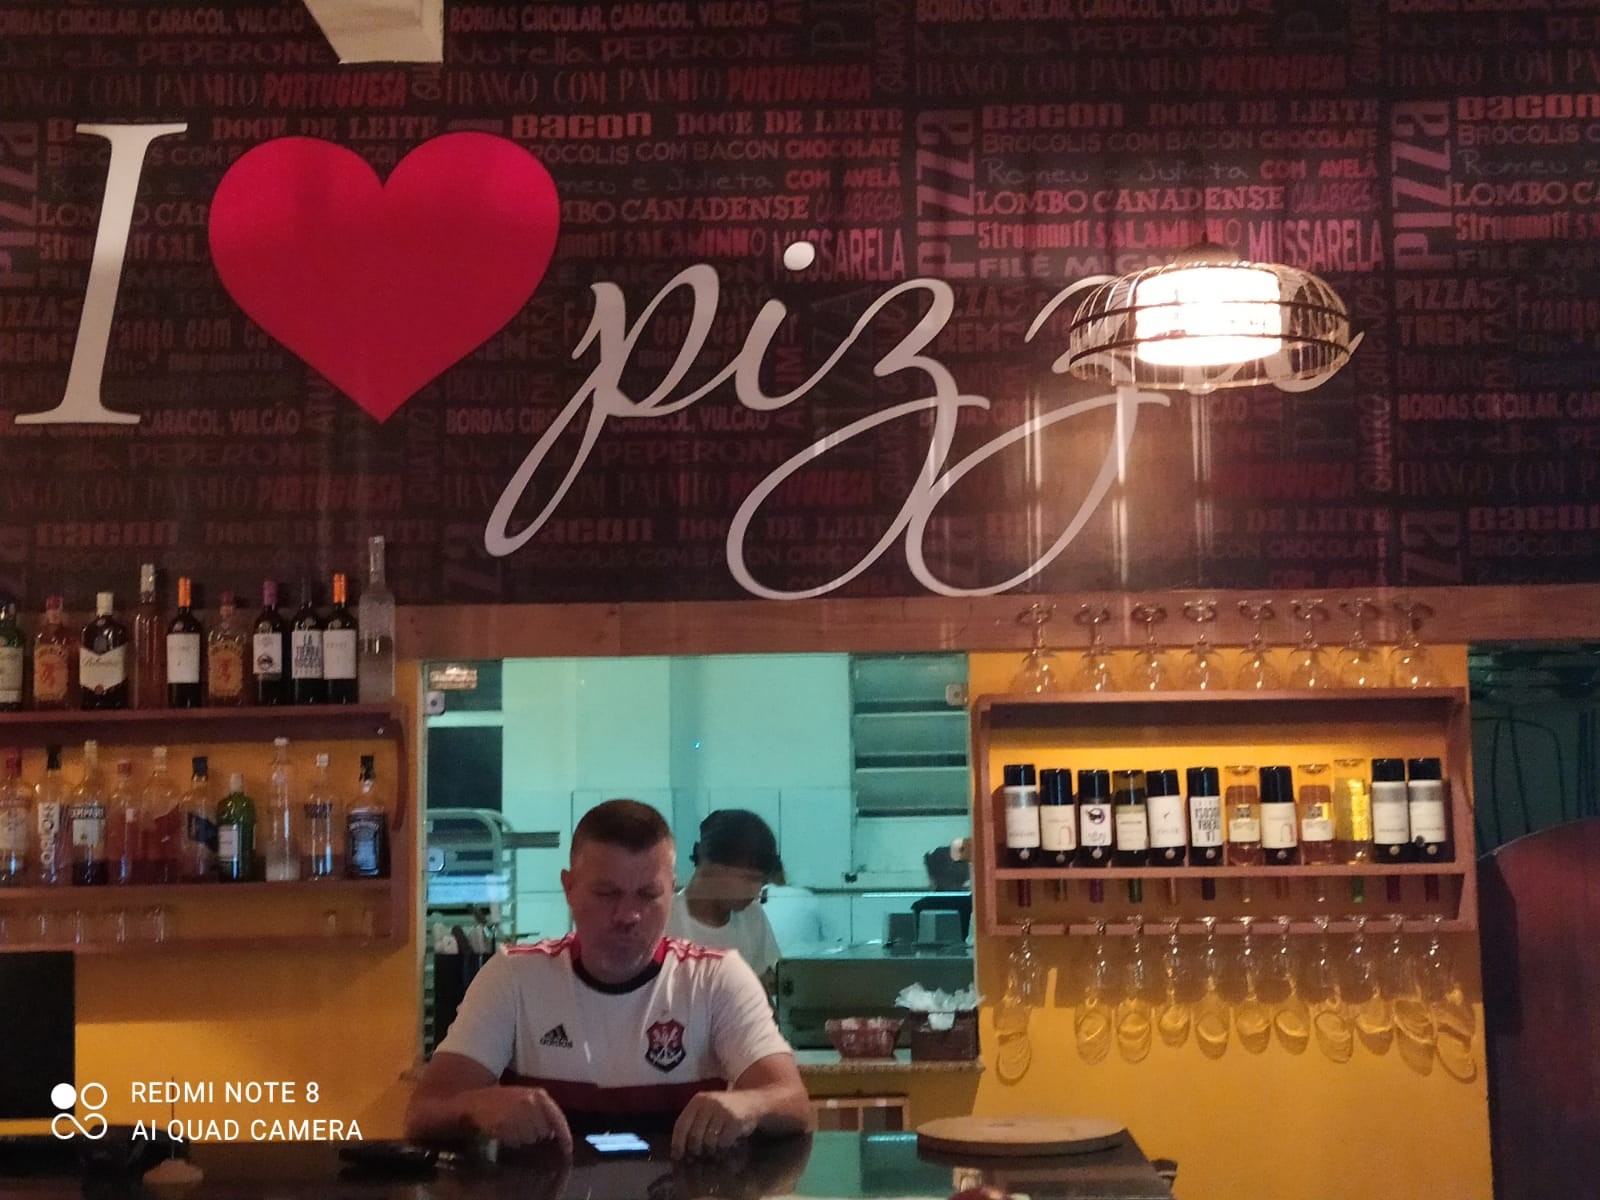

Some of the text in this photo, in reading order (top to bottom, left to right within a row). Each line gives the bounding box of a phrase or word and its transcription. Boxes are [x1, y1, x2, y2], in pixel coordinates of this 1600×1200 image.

[620, 195, 809, 222] CANADENSE
[975, 188, 1088, 216] LOMBO
[1092, 184, 1287, 215] CANADENSE
[1451, 180, 1570, 208] LOMBO
[1247, 217, 1386, 273] MUSSARELA
[15, 122, 1364, 600] I pizz
